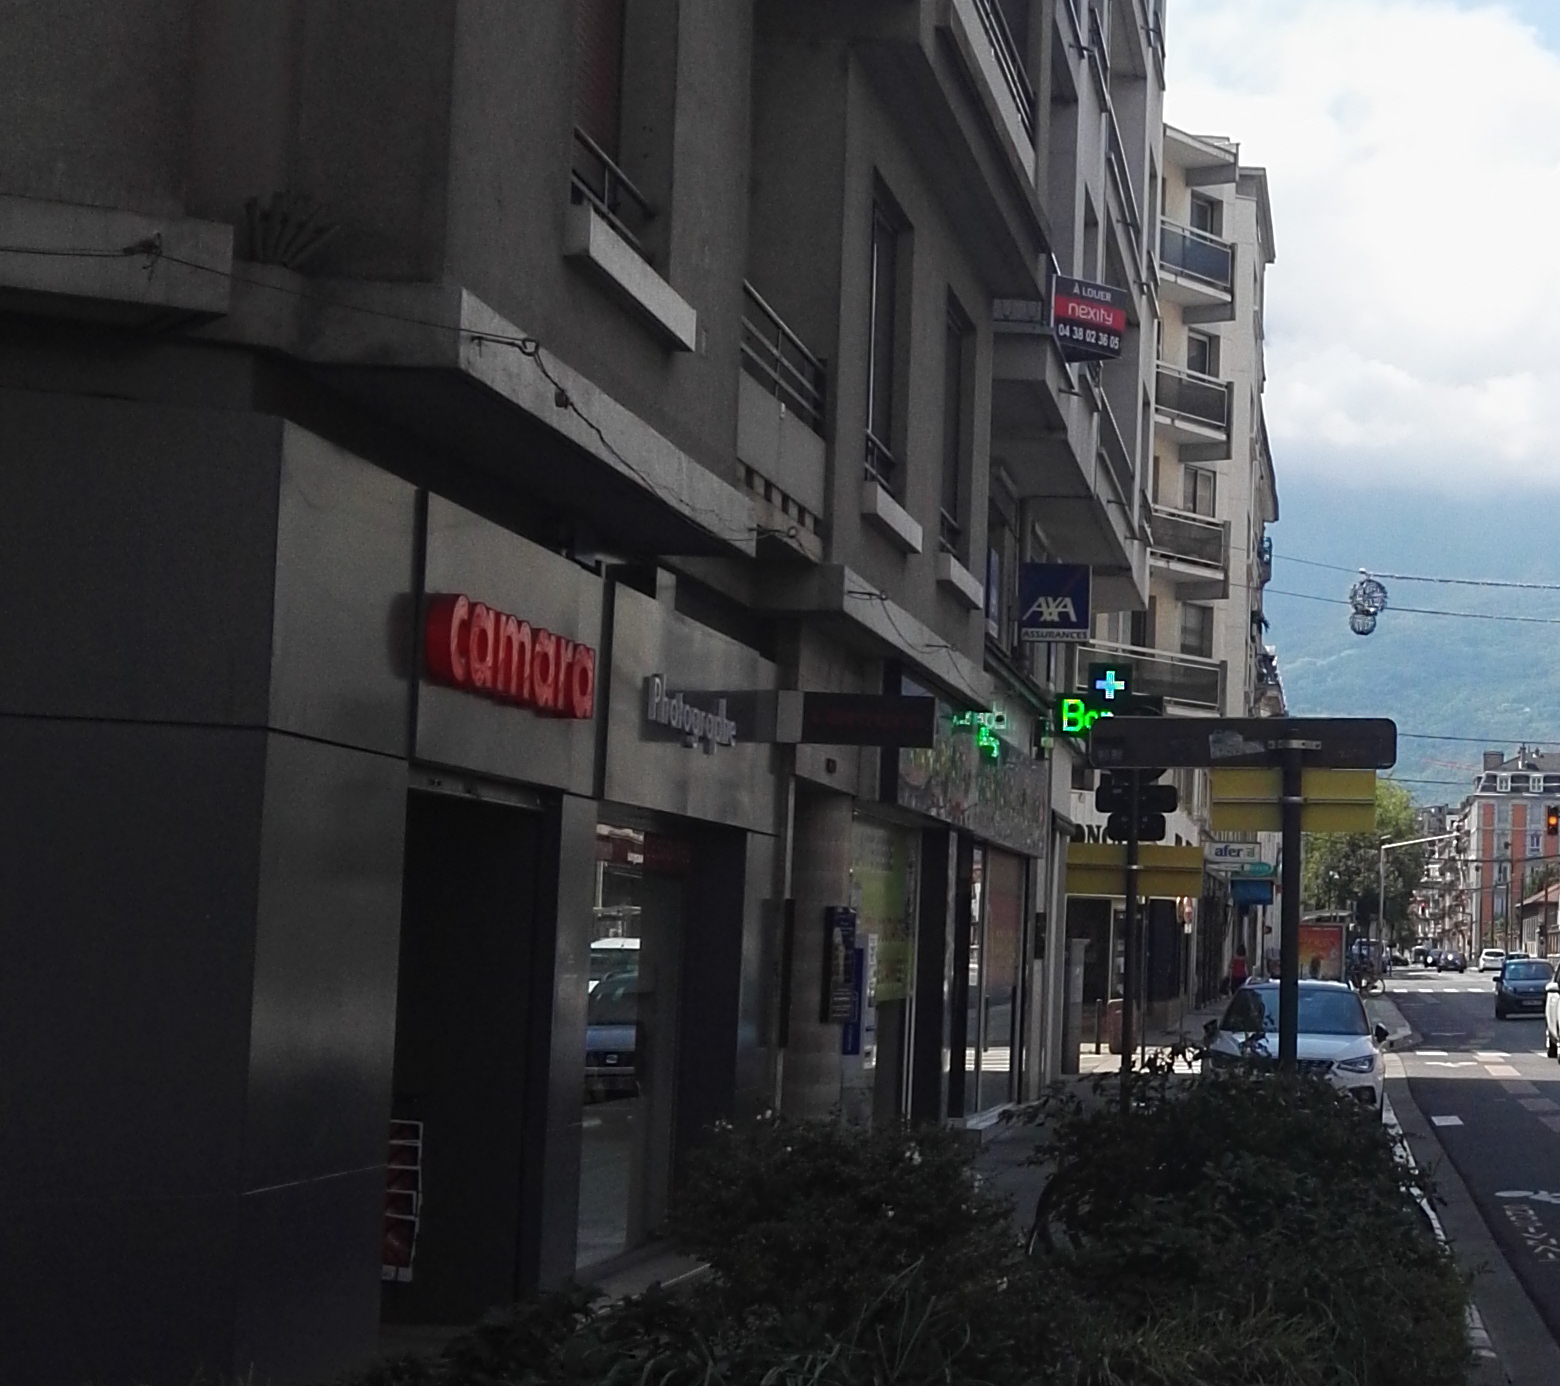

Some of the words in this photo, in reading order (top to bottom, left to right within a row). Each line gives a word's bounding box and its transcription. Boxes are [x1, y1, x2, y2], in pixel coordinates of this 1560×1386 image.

[1082, 286, 1112, 302] LOUER
[1068, 303, 1114, 325] nexity
[1058, 324, 1070, 337] 04
[1072, 326, 1084, 340] 38
[1085, 329, 1096, 343] 02
[1022, 596, 1078, 623] AXA
[448, 593, 595, 719] camara
[1214, 844, 1244, 857] afer
